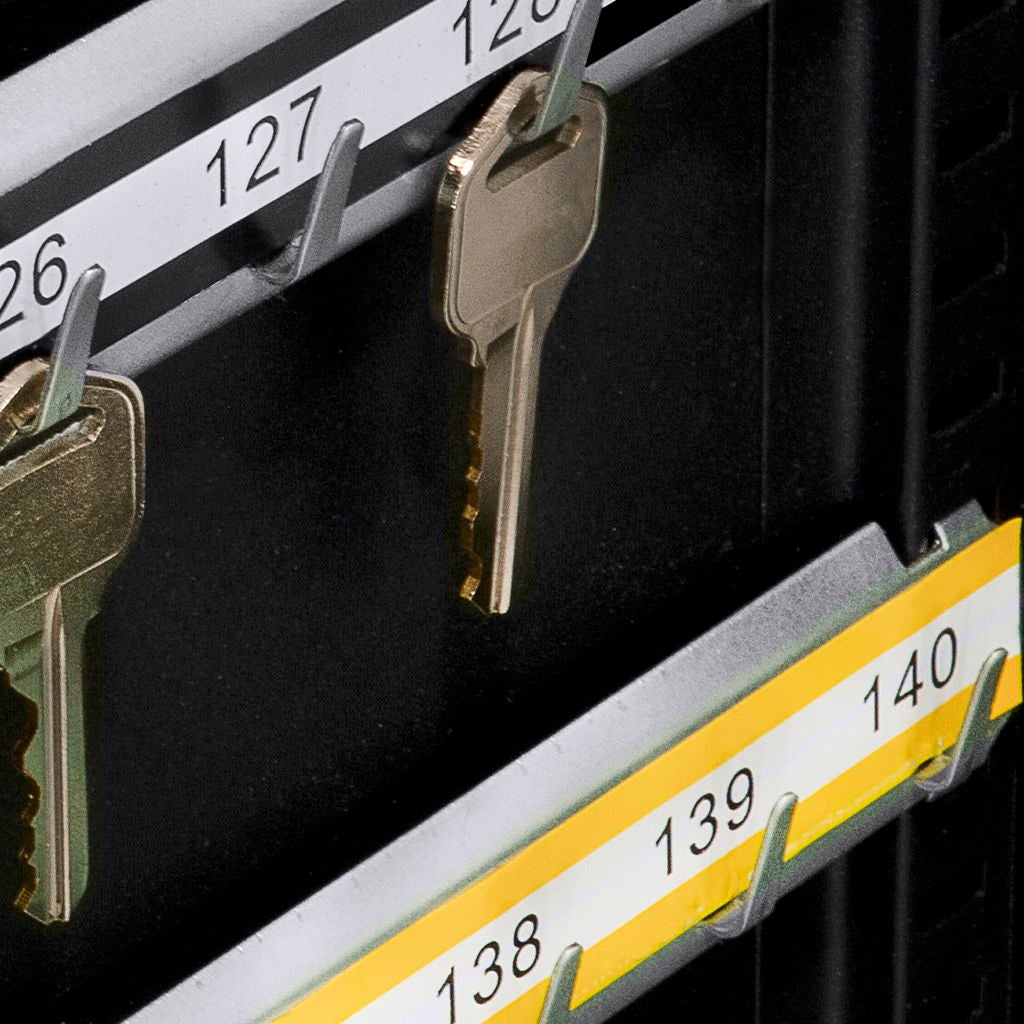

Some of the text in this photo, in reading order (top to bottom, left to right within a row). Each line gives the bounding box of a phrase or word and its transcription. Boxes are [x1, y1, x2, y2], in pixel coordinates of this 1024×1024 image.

[206, 85, 322, 207] 127
[438, 627, 957, 1024] 138 139 140
